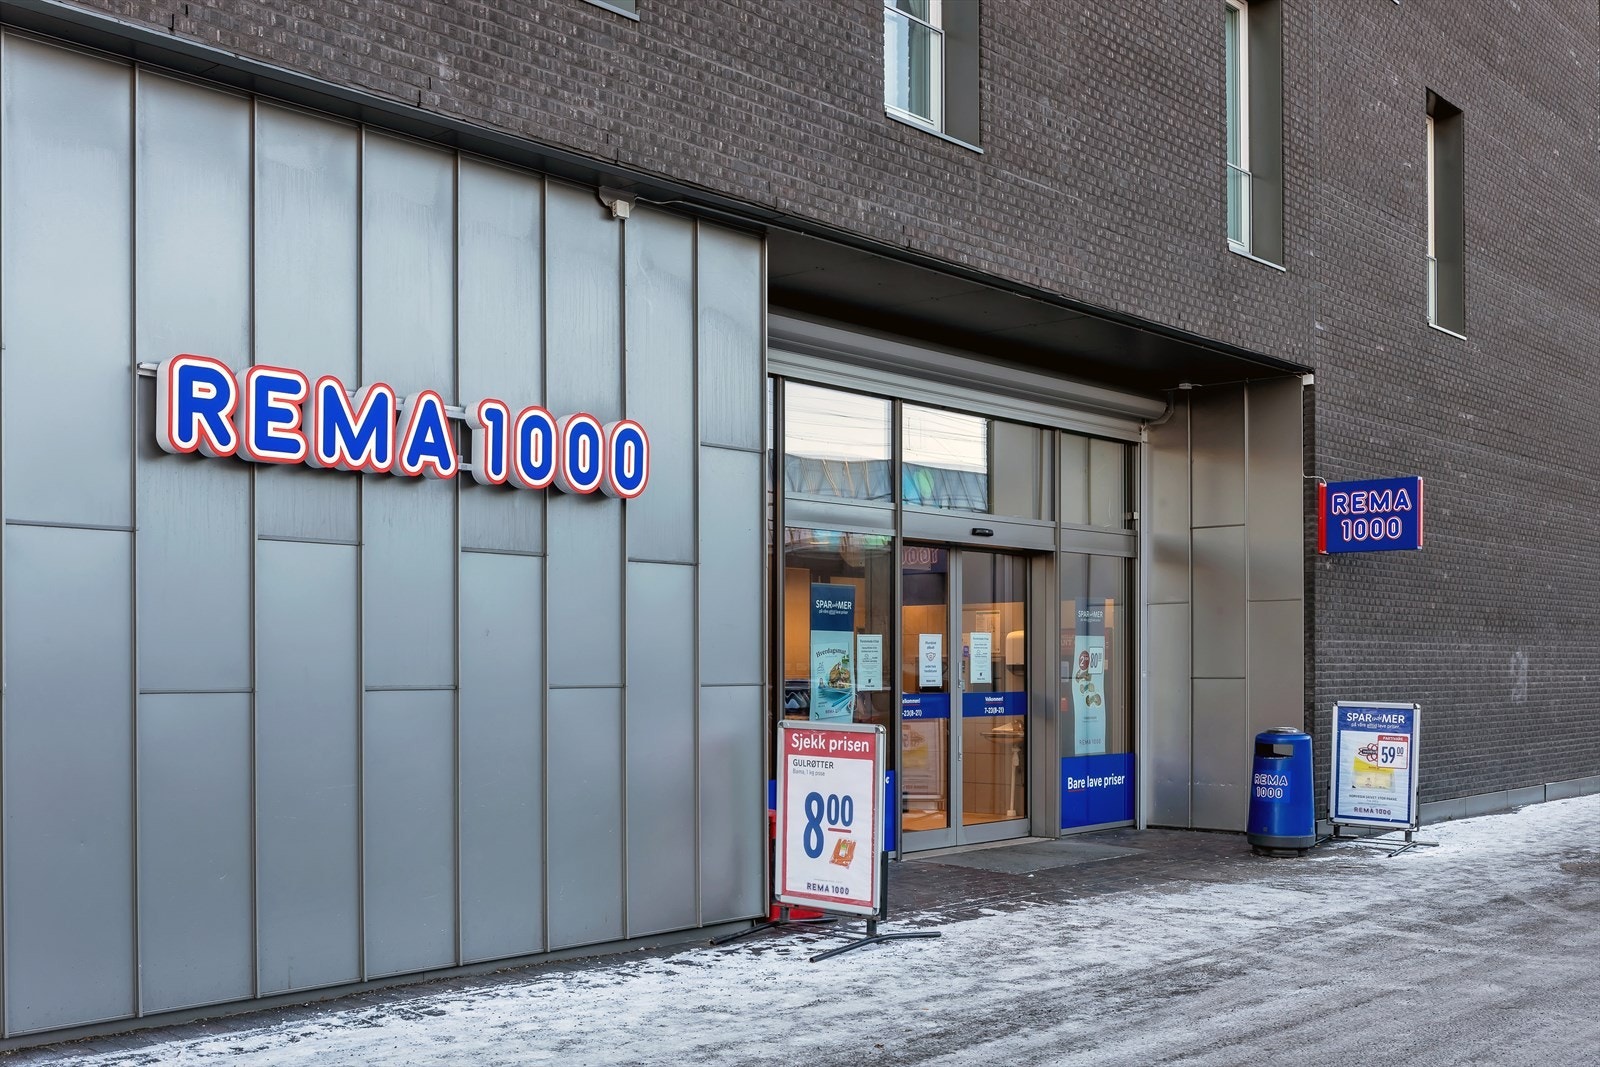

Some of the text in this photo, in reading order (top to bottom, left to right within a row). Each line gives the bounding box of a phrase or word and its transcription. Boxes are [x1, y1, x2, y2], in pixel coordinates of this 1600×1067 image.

[164, 353, 650, 499] REMA 1000
[1331, 488, 1412, 515] REMA
[1341, 516, 1402, 542] 1000
[815, 599, 833, 609] SPAR
[838, 600, 852, 610] MER
[1077, 610, 1090, 618] SPAR
[1093, 610, 1103, 618] MER
[1346, 712, 1372, 723] SPAR
[1382, 714, 1405, 724] MER
[791, 732, 869, 753] Sjekk prisen
[1381, 746, 1396, 764] 59
[792, 758, 834, 769] GULRØTTER
[1067, 774, 1126, 791] Bare lave priser
[1254, 773, 1288, 787] REMA
[1256, 786, 1283, 799] 1000
[1353, 806, 1374, 814] REMA
[803, 791, 825, 859] 8
[806, 882, 850, 895] REMA 1000
